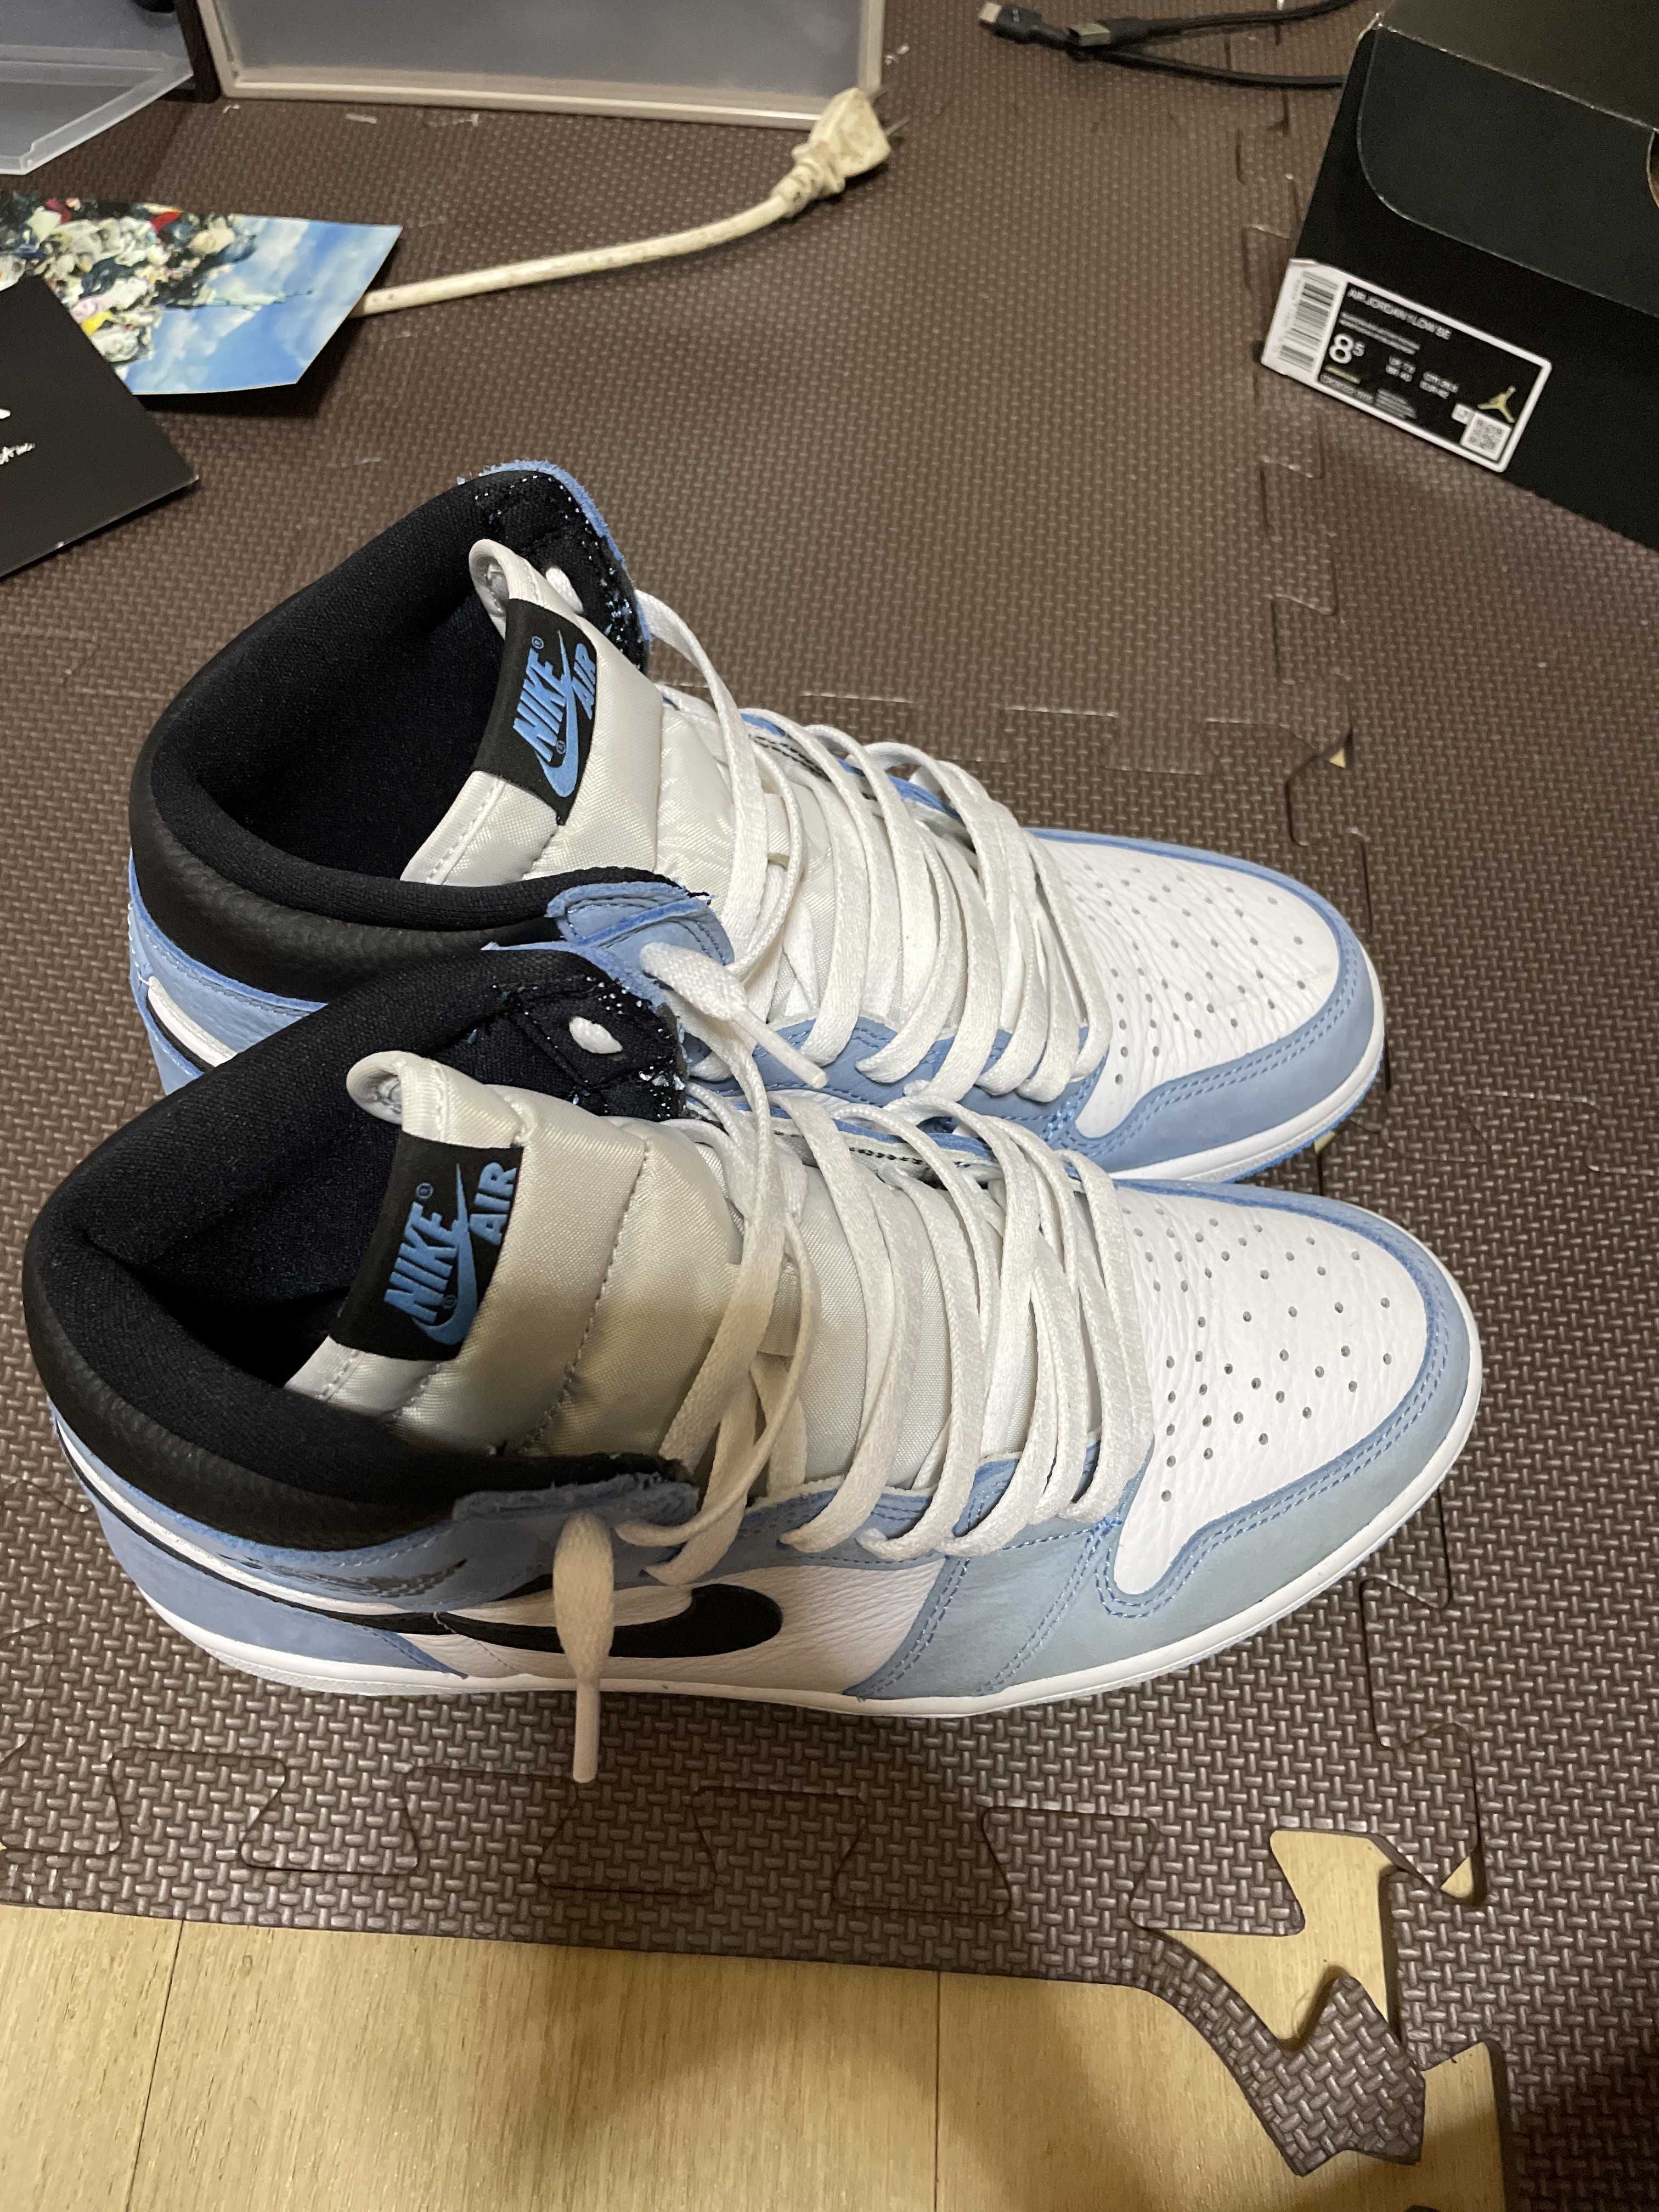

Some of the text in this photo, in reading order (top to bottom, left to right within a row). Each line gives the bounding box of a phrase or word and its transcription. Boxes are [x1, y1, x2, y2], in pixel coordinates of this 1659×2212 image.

[513, 647, 566, 762] NIKE
[385, 1161, 517, 1324] NIKE AIR
